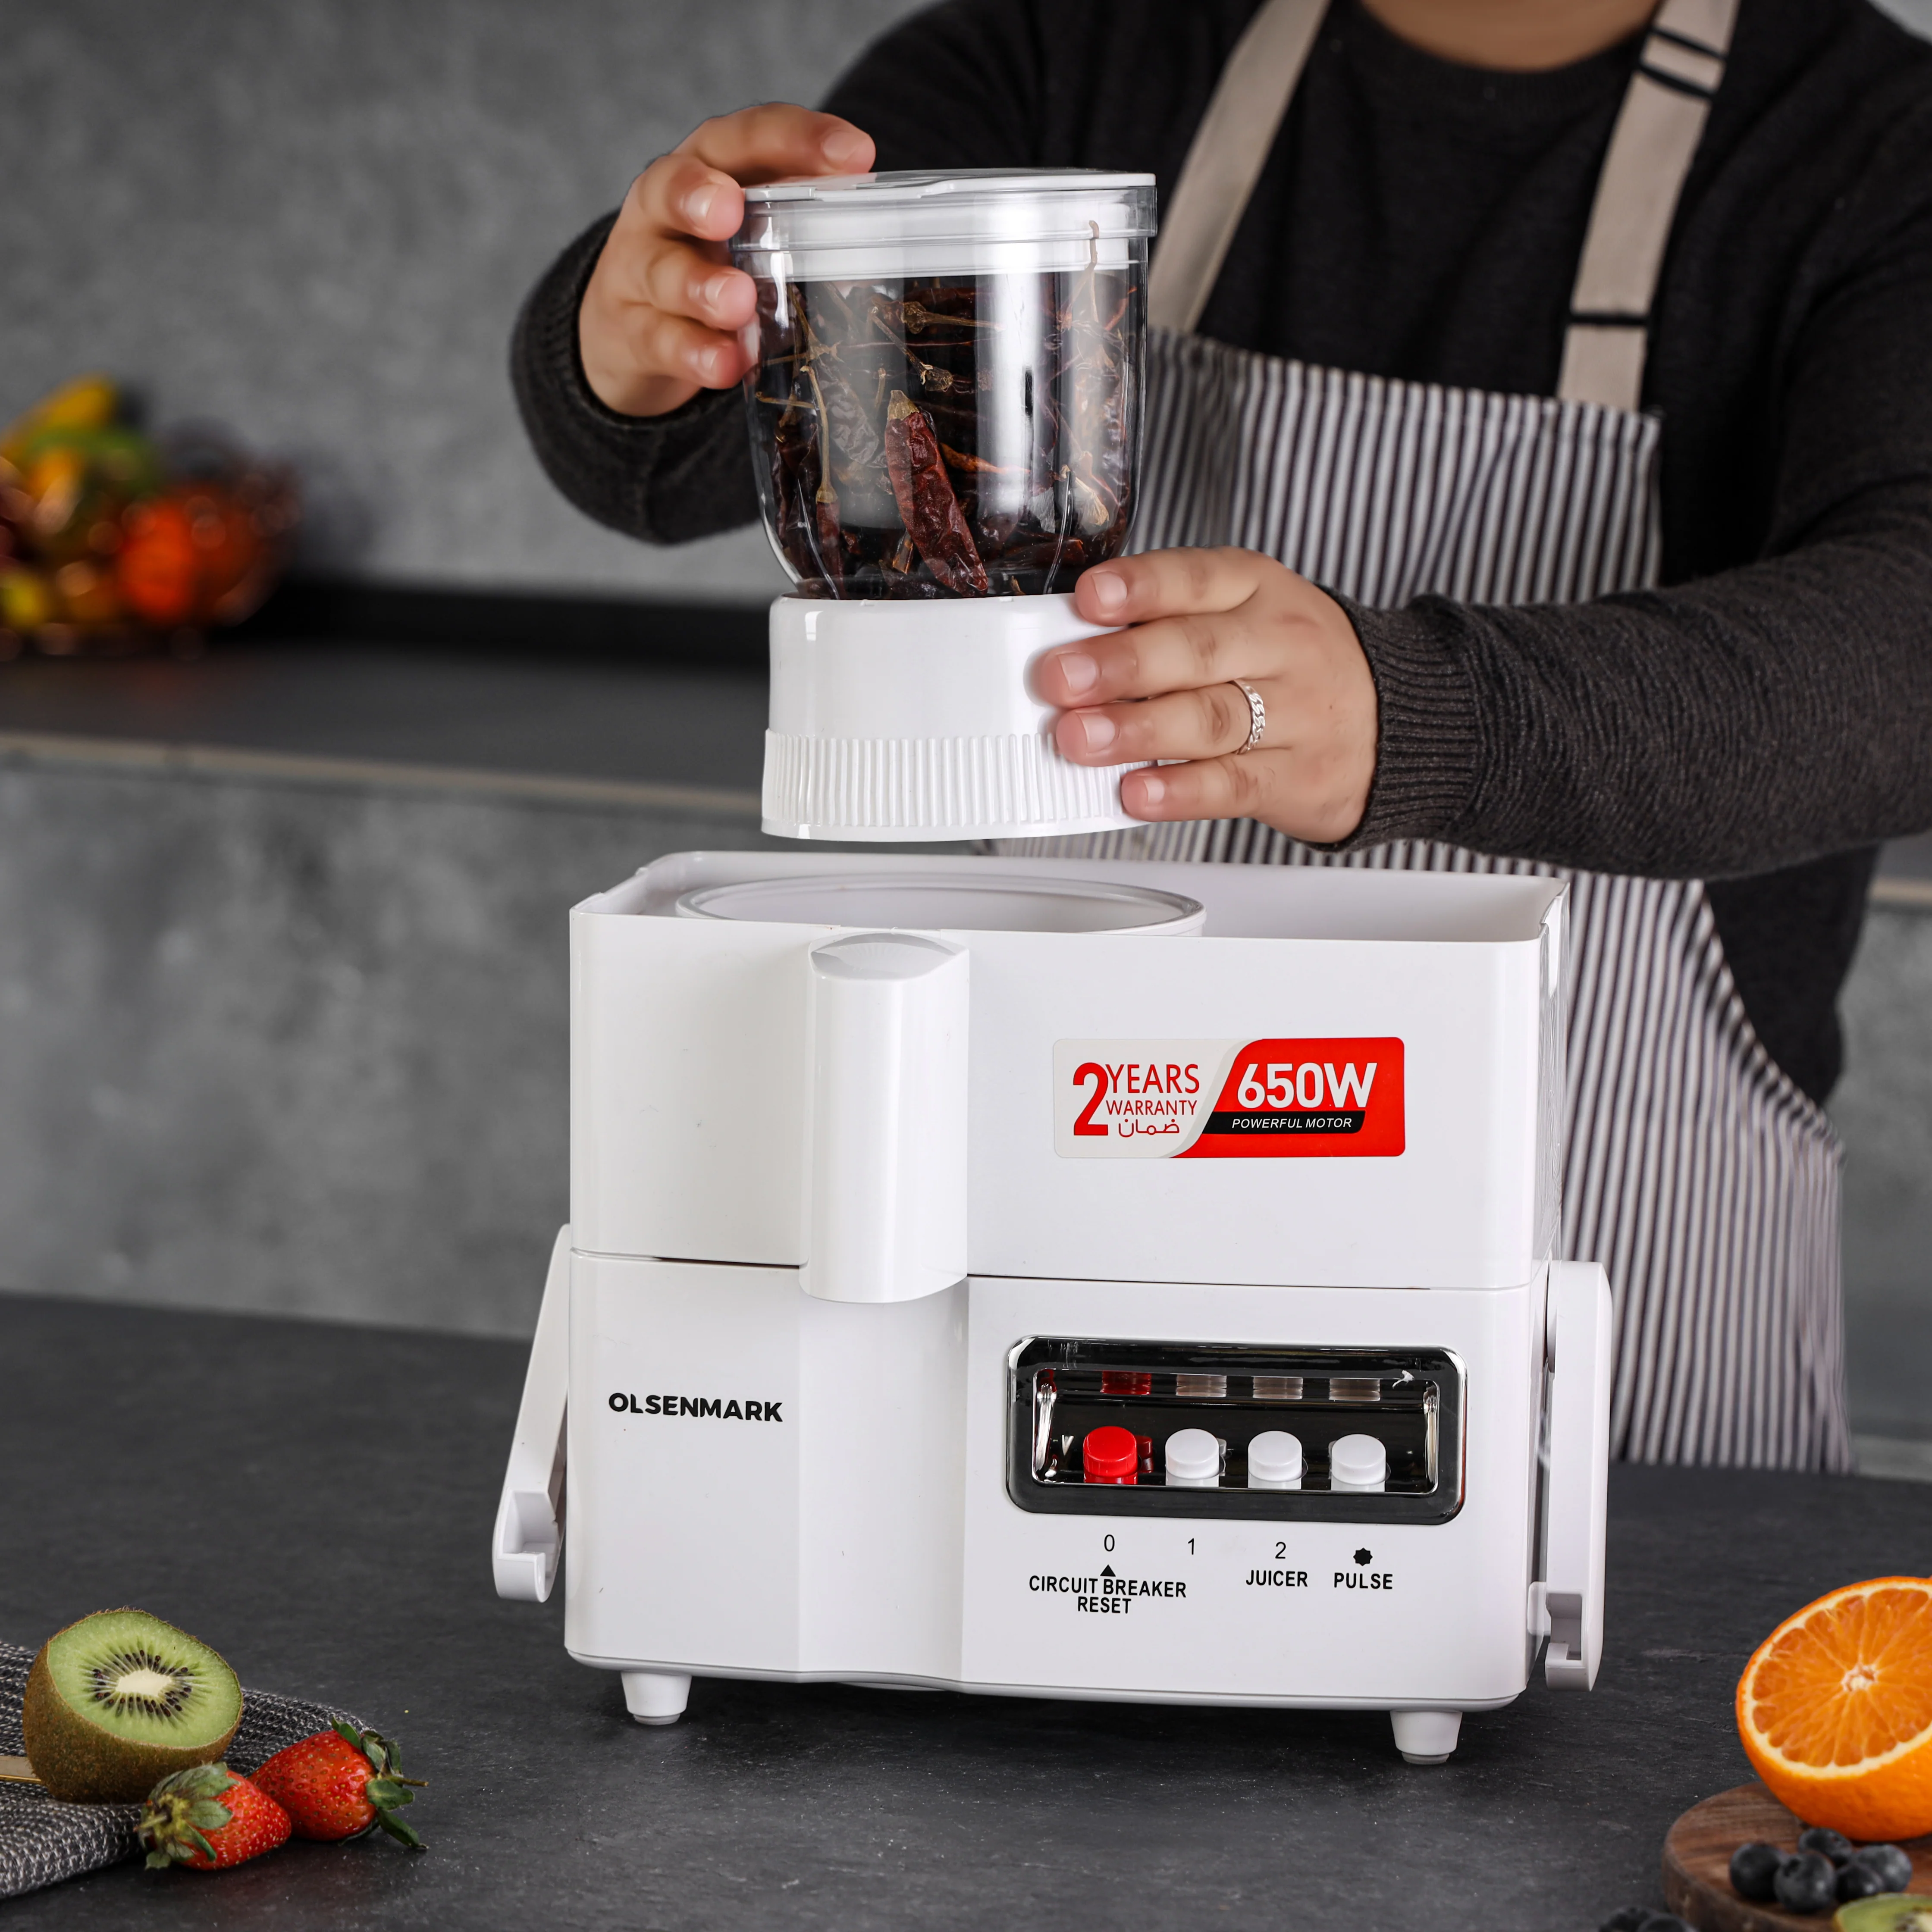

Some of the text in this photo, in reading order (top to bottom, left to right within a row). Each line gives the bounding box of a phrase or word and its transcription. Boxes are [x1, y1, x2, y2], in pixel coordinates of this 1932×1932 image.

[1237, 1062, 1377, 1109] 650W
[1073, 1062, 1200, 1136] 2 YEARS
[1106, 1100, 1197, 1115] WARRANTY
[1118, 1118, 1180, 1138] ضمان
[1232, 1118, 1352, 1129] POWERFUL MOTOR
[608, 1393, 783, 1422] OLSENMARK
[1104, 1534, 1115, 1552] 0
[1187, 1537, 1195, 1555] 1
[1274, 1541, 1286, 1559] 2
[1029, 1575, 1187, 1598] CIRCUIT BREAKER
[1245, 1570, 1308, 1587] JUICER
[1334, 1572, 1393, 1590] PULSE
[1077, 1596, 1132, 1614] RESET
